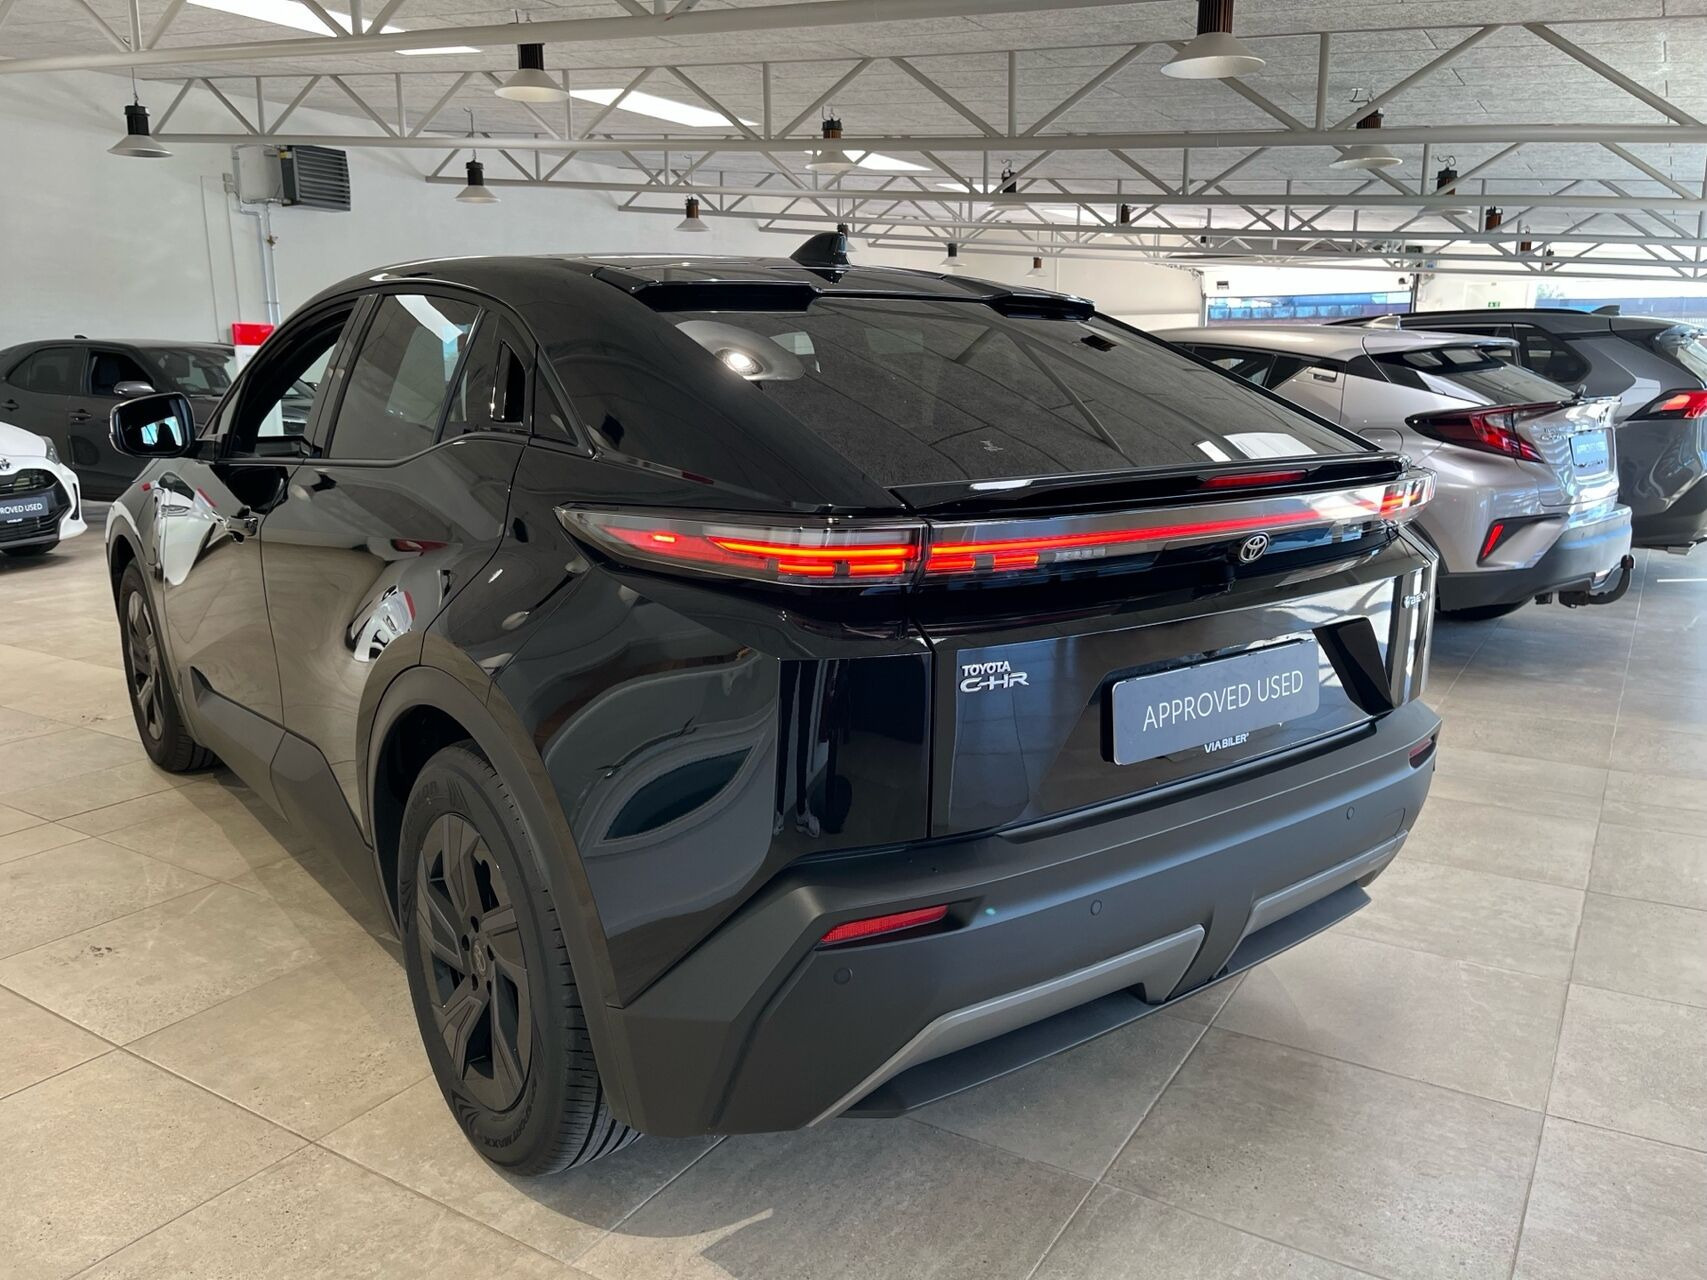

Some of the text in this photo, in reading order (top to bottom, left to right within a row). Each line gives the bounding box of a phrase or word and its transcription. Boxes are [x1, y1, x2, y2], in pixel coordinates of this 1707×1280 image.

[0, 503, 43, 514] ROVED USED
[962, 660, 1011, 677] TOYOTA
[960, 672, 1030, 693] C-HR
[1142, 670, 1304, 732] APPROVED USED
